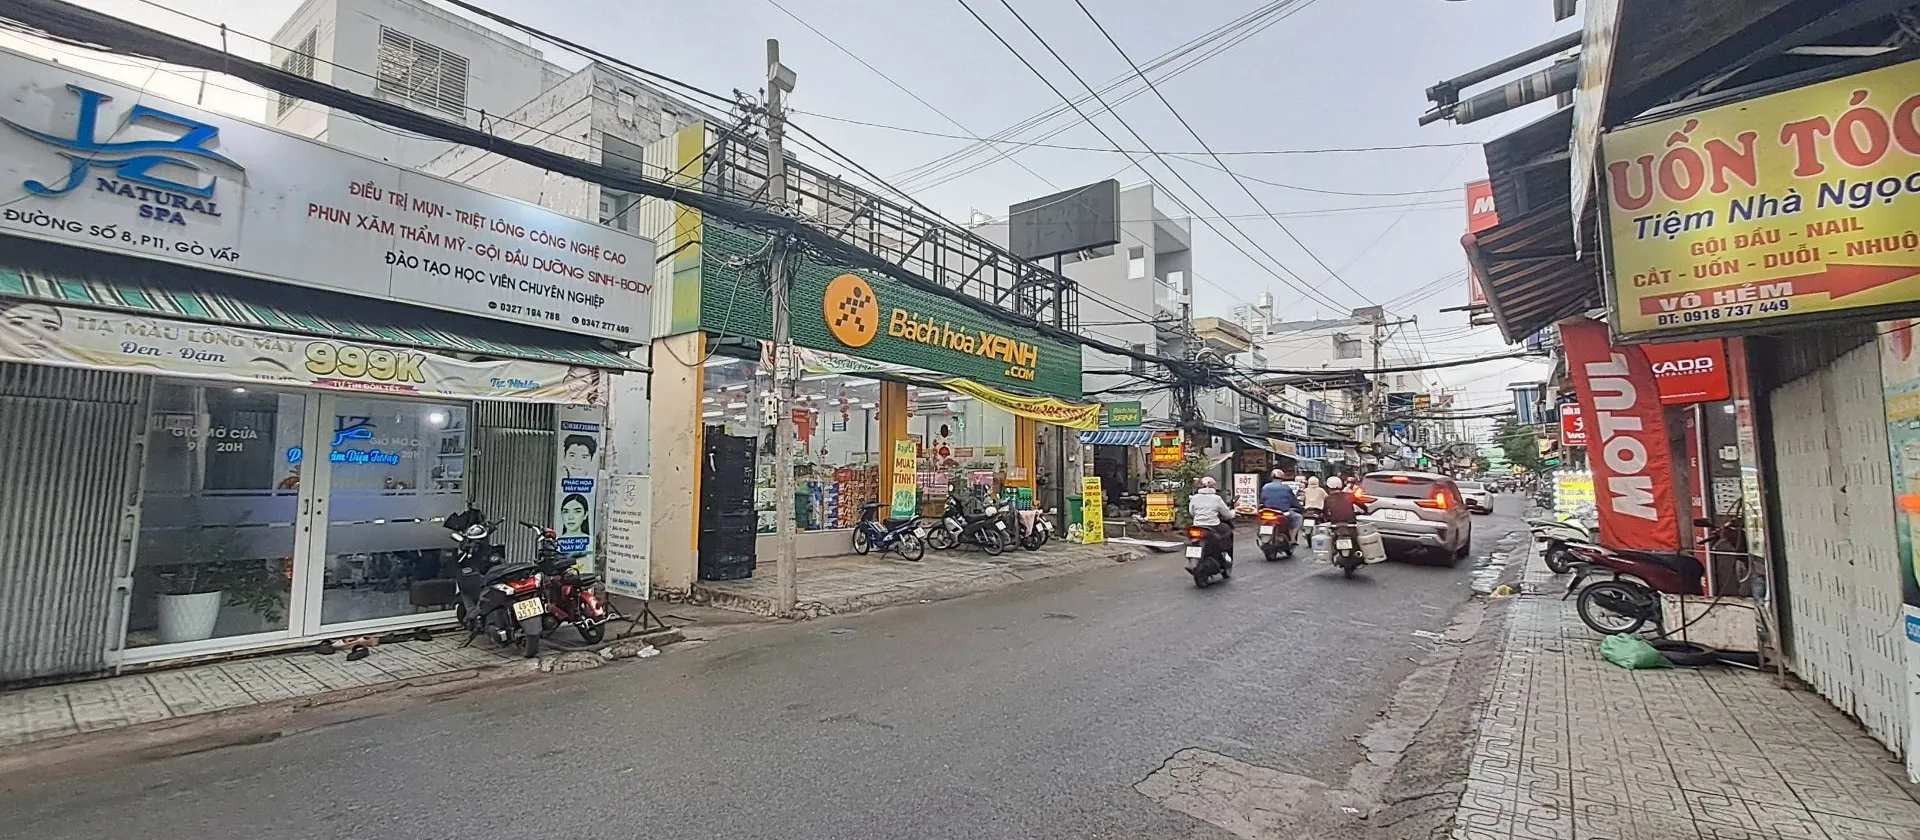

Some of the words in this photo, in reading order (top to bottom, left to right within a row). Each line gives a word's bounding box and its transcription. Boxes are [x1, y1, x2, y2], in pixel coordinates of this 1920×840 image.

[1608, 119, 1757, 211] UỐN
[97, 178, 222, 218] NATURAL
[139, 204, 186, 226] SPA
[1634, 208, 1714, 240] Tiệm
[1728, 188, 1802, 224] Nhà
[4, 206, 82, 233] ĐƯỜNG
[89, 224, 117, 240] SỐ
[175, 240, 204, 256] GÒ
[209, 246, 240, 263] VẤP
[308, 203, 350, 226] PHUN
[356, 213, 395, 237] XĂM
[400, 223, 440, 248] THẨM
[444, 233, 466, 251] MỸ
[475, 243, 500, 263] GỘI
[505, 249, 529, 268] ĐẦU
[533, 256, 584, 280] DƯỠNG
[349, 180, 382, 202] ĐIỀU
[388, 191, 408, 213] TRỊ
[412, 199, 444, 219] MỤN
[455, 209, 487, 231] TRIỆT
[490, 216, 525, 238] LÔNG
[530, 227, 566, 250] CÔNG
[570, 240, 600, 259] NGHỆ
[603, 249, 627, 266] CAO
[1691, 237, 1727, 257] GỘI
[1806, 216, 1864, 238] NAIL
[385, 250, 419, 270] ĐÀO
[423, 260, 451, 279] TẠO
[455, 266, 485, 285] HỌC
[489, 273, 516, 291] VIÊN
[518, 279, 566, 302] CHUYÊN
[567, 289, 605, 309] NGHIỆP
[1634, 265, 1671, 288] CẮT
[1694, 255, 1740, 280] UỐN
[1845, 230, 1920, 257] NHUỘ
[1658, 312, 1680, 326] ĐT:
[1684, 307, 1721, 323] 0918
[1725, 303, 1754, 319] 737
[1758, 299, 1790, 315] 449
[1659, 291, 1703, 311] VÔ
[77, 316, 114, 336] HẠ
[123, 321, 179, 341] MÀU
[187, 327, 245, 348] LÔNG
[252, 335, 298, 354] MÀY
[120, 341, 162, 357] Đen
[179, 346, 228, 364] Đậm
[888, 309, 939, 346] Bách
[942, 322, 976, 353] hóa
[976, 331, 1039, 369] XANH
[304, 342, 428, 384] 999K
[216, 442, 244, 453] 20H
[1585, 353, 1659, 523] MOTUL
[893, 470, 911, 485] TÍNH
[896, 458, 910, 469] MUA
[911, 461, 916, 470] 2
